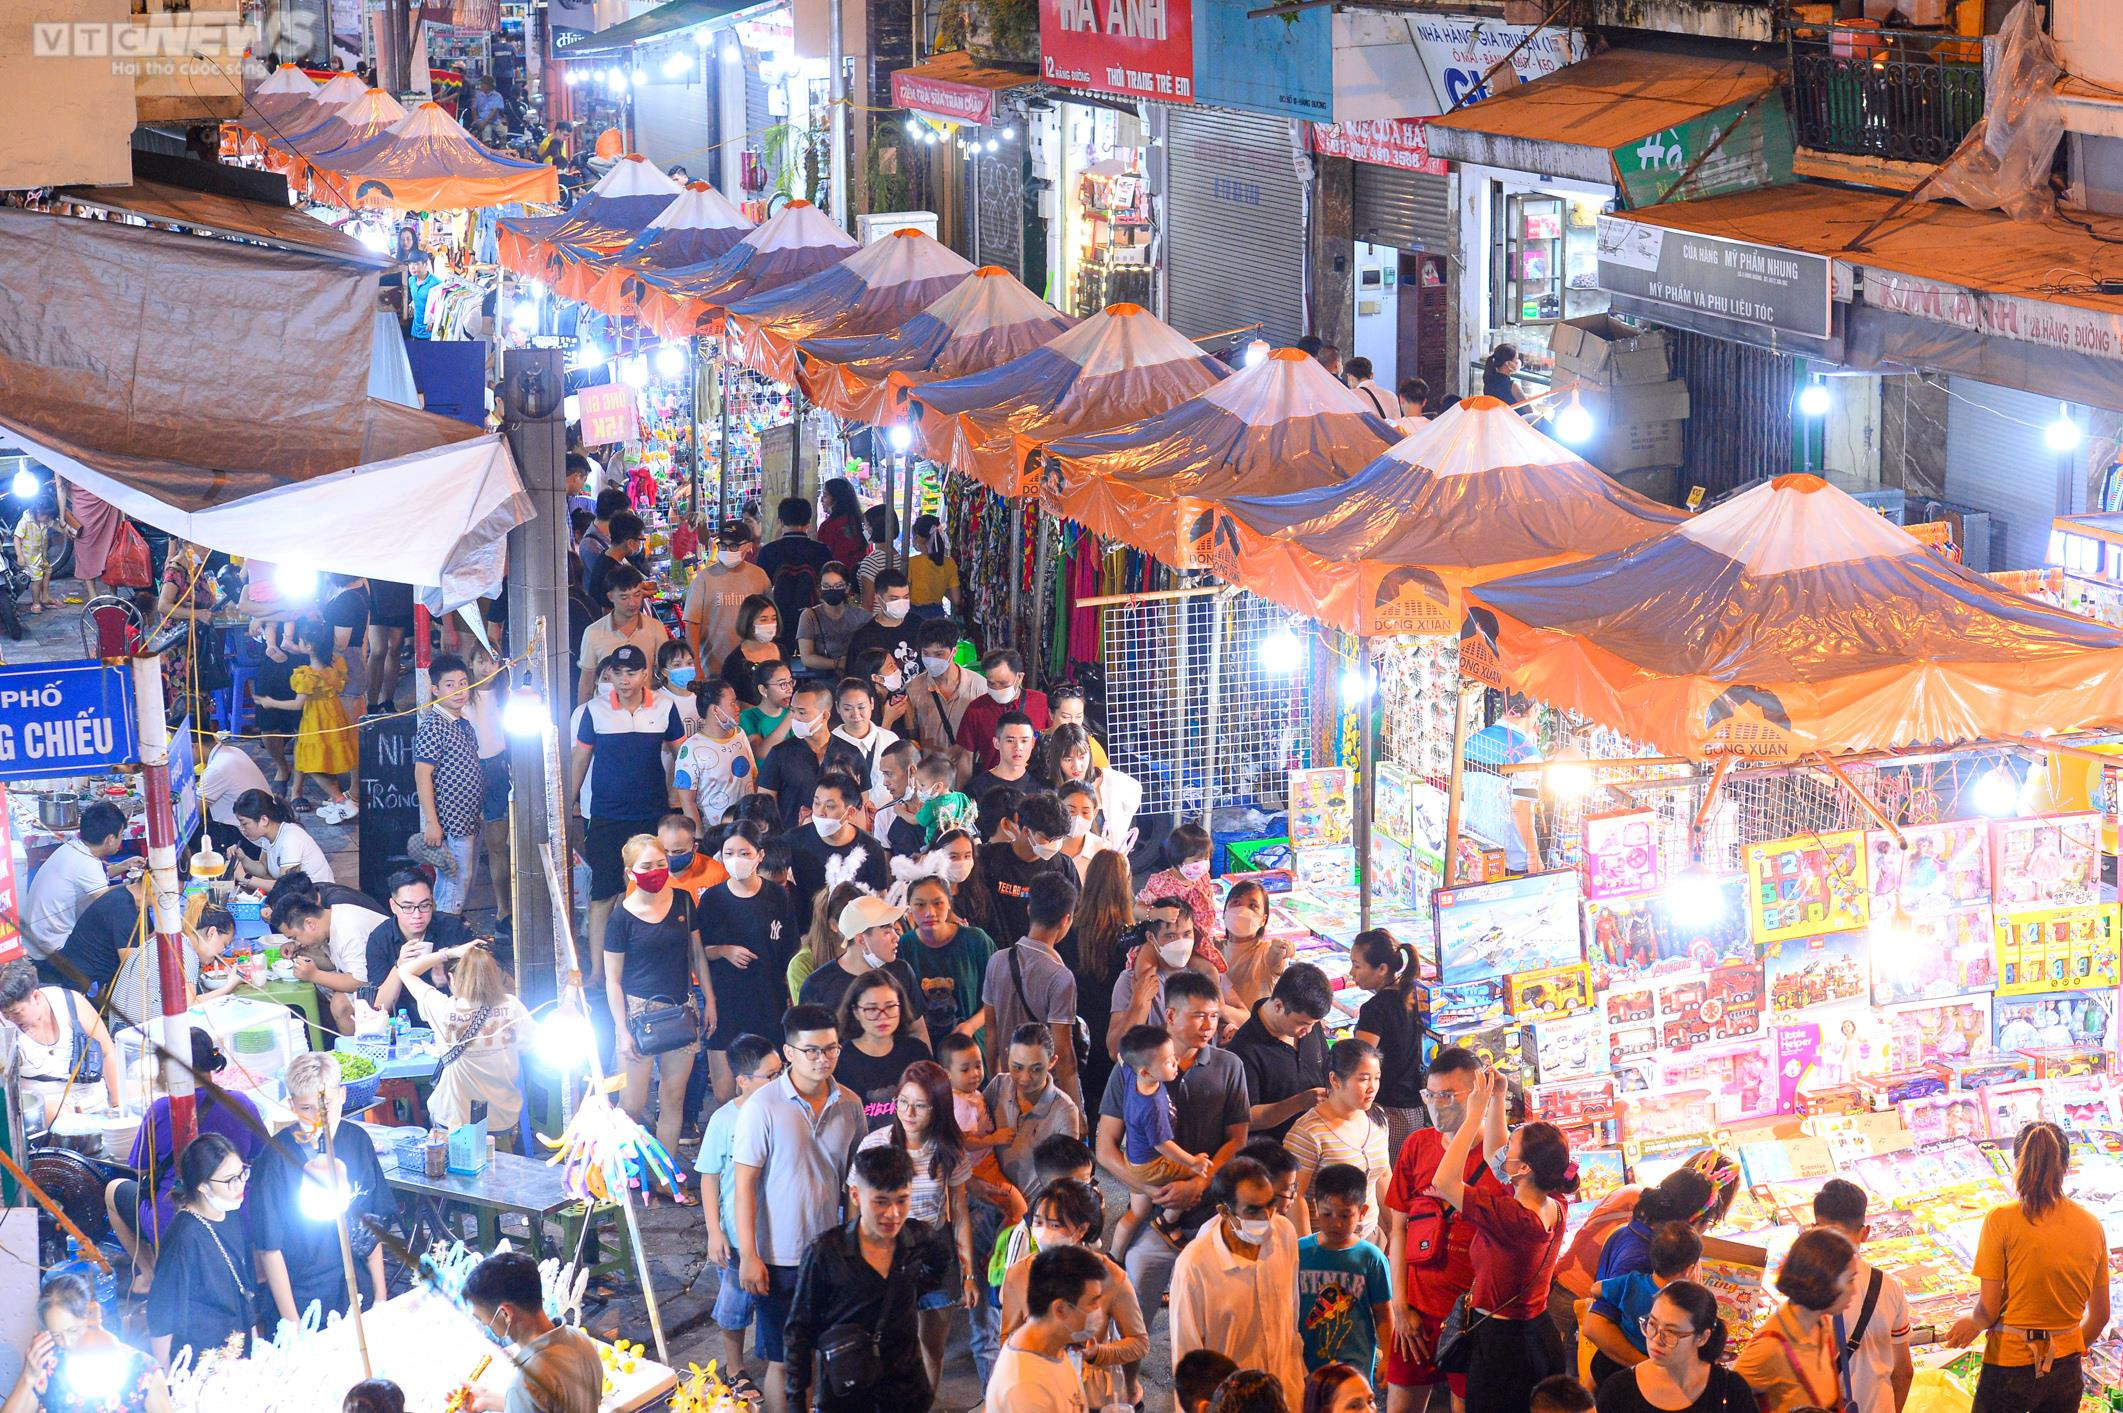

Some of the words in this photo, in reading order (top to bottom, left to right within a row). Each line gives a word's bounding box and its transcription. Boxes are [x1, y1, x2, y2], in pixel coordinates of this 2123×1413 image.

[1417, 23, 1445, 43] NHÀ
[1479, 32, 1500, 48] GIA
[1045, 56, 1055, 78] 12
[1106, 63, 1124, 88] THỜI
[1126, 70, 1154, 91] TRANG
[1156, 70, 1172, 94] TRẺ
[1175, 77, 1191, 97] EM
[1370, 146, 1390, 163] 490
[1392, 151, 1420, 167] 3588
[1683, 244, 1699, 262] CỬA
[1699, 248, 1719, 265] HÀNG
[1724, 249, 1738, 268] MỸ
[1740, 249, 1765, 273] PHẨM
[1767, 257, 1799, 280] NHUNG
[1649, 281, 1663, 298] MỸ
[1665, 283, 1691, 303] PHẨM
[1693, 289, 1706, 307] VÀ
[1708, 294, 1728, 313] PHỤ
[1730, 297, 1752, 318] LIỆU
[1754, 302, 1774, 322] TÓC
[1880, 276, 1943, 320] KIM
[1952, 291, 2018, 334] ANH
[2075, 322, 2111, 352] ĐƯỜNG
[0, 680, 63, 708] PHỐ
[23, 707, 114, 760] CHIẾU
[1749, 743, 1788, 756] XUAN
